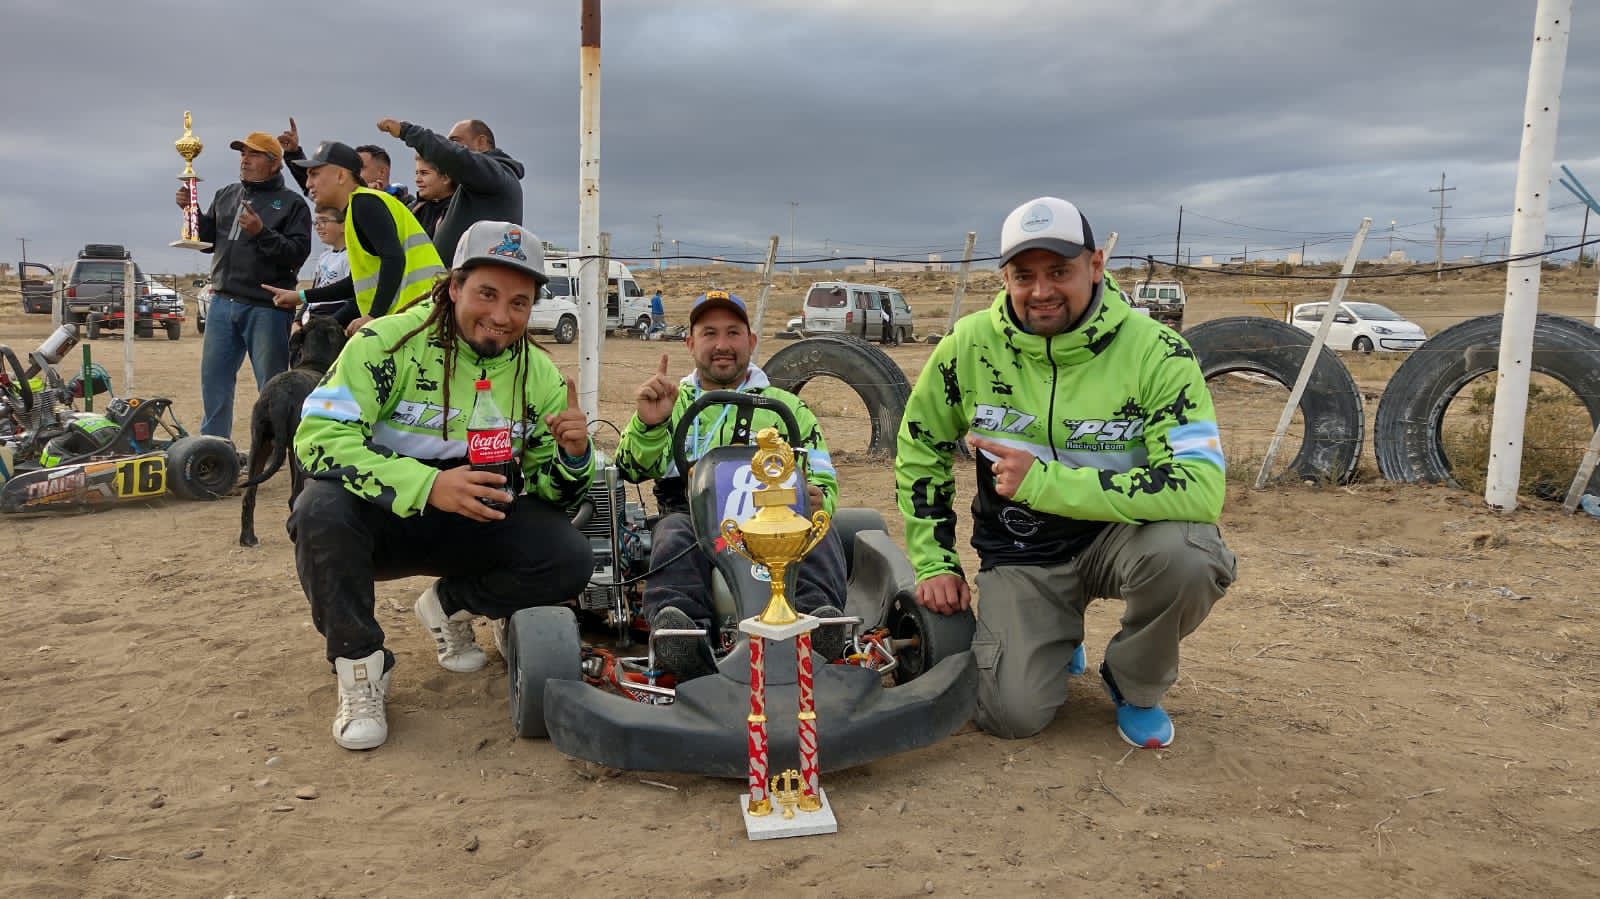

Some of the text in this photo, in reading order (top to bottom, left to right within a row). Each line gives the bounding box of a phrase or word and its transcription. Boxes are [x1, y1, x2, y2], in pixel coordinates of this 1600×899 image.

[1066, 441, 1125, 451] Racing Team
[118, 460, 163, 495] 16
